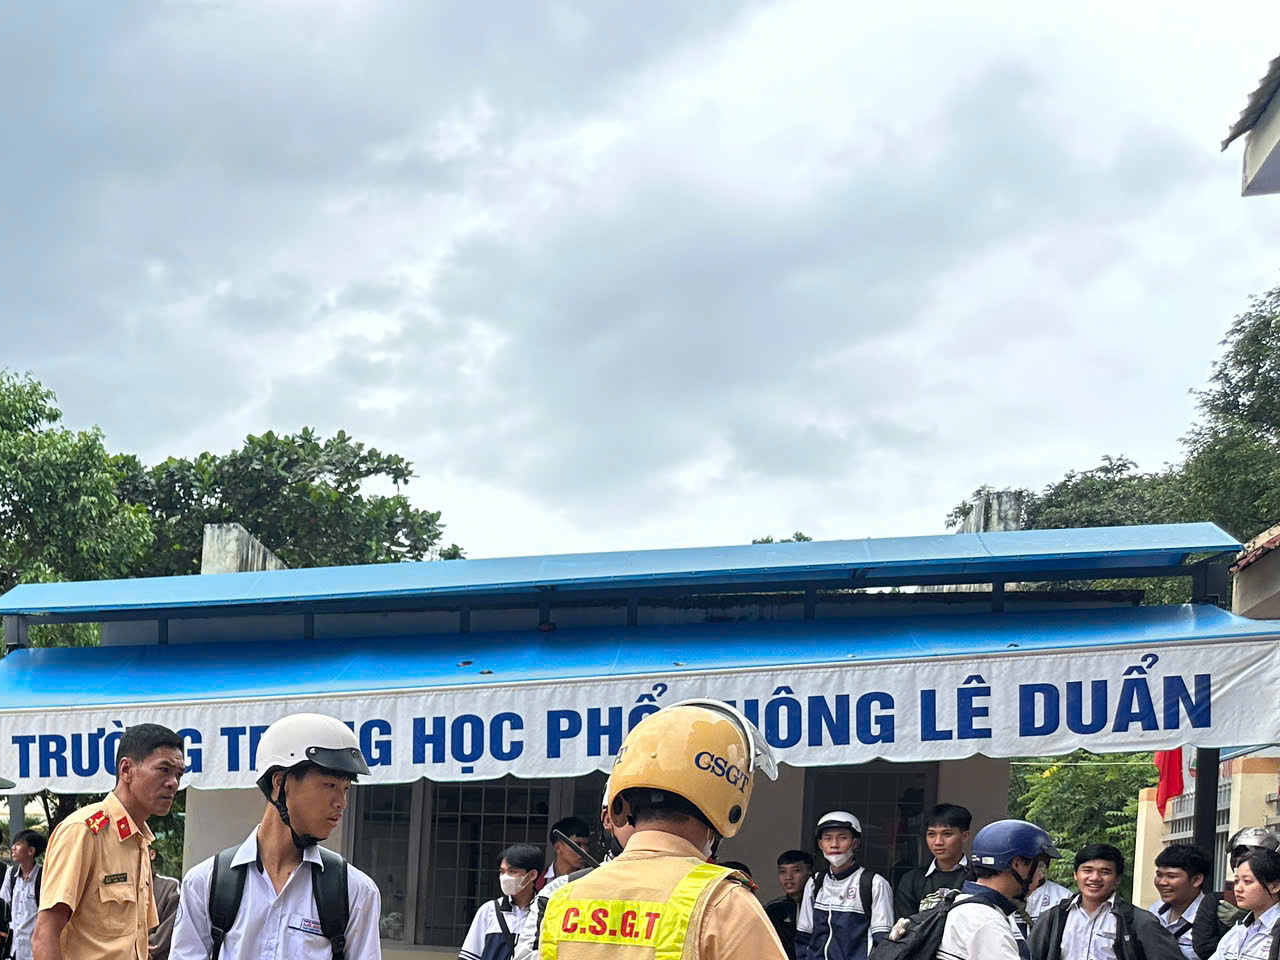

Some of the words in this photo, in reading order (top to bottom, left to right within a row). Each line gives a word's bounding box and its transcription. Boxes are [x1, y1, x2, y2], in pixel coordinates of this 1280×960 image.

[11, 720, 202, 778] TRƯG
[412, 712, 524, 774] HỌC
[723, 685, 895, 749] ÔNG
[920, 674, 992, 742] LÊ
[1018, 653, 1212, 737] DUẨN
[694, 751, 749, 794] CSGT
[561, 907, 661, 940] C.S.G.T
